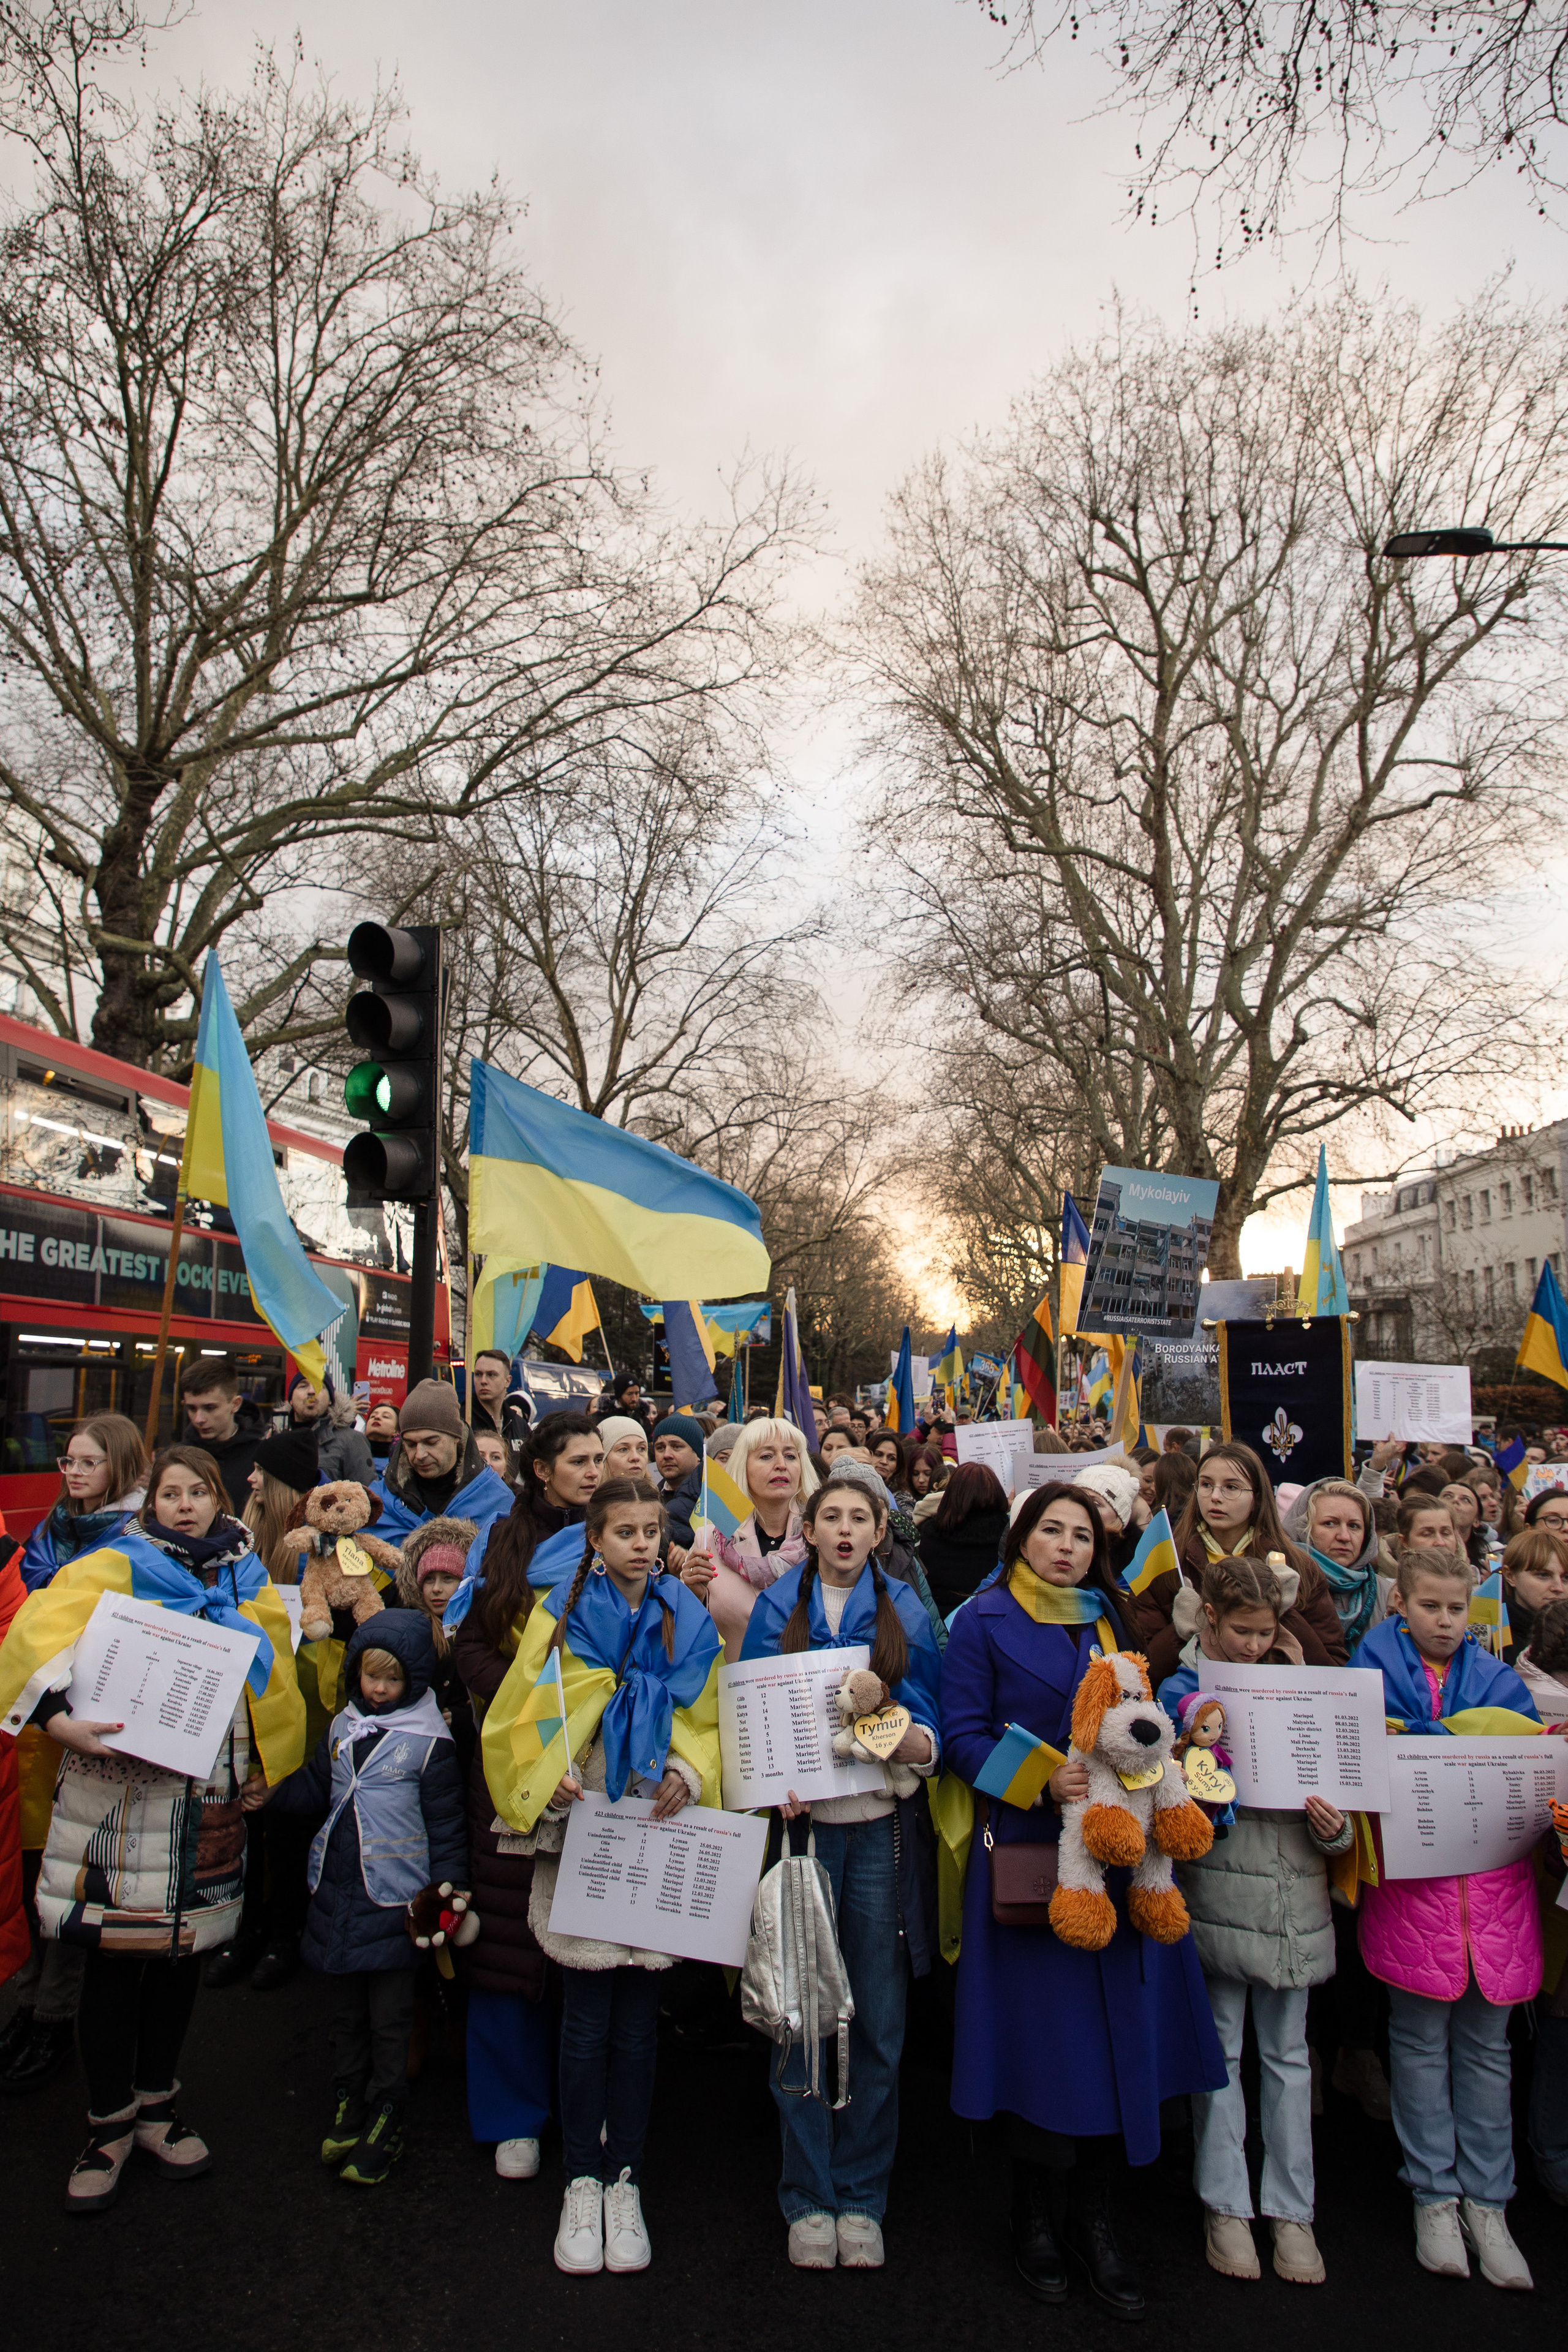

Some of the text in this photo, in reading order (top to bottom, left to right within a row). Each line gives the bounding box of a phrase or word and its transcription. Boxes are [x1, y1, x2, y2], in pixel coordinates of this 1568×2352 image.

[1129, 1183, 1191, 1205] Mykolayiv
[40, 1237, 160, 1281] GREATEST
[165, 1259, 214, 1291] OCK
[1103, 1315, 1172, 1326] #RUSSIAISATERRORISTSTATE
[1164, 1354, 1207, 1363] RUSSIAN
[368, 1357, 405, 1379] Metroline
[980, 1360, 995, 1374] 365
[1251, 1362, 1307, 1375] ПЛАСТ
[345, 1546, 364, 1566] Tiana
[859, 1717, 904, 1736] Tymur
[872, 1732, 895, 1741] Kherson
[1194, 1772, 1212, 1792] Sumy
[1197, 1760, 1226, 1793] Kyryl
[669, 1844, 689, 1852] Mariupol
[699, 1849, 722, 1858] 26.05.2022
[699, 1842, 722, 1851] 25.05.2022
[698, 1856, 720, 1864] 18.05.2022
[665, 1864, 685, 1872] Mariupol
[696, 1863, 719, 1872] 18.05.2022
[664, 1871, 684, 1879] Mariupol
[694, 1877, 717, 1885] 12.03.2022
[660, 1891, 680, 1900] Mariupol
[655, 1904, 680, 1914] Volnovakha
[657, 1898, 682, 1907] Volnovakha
